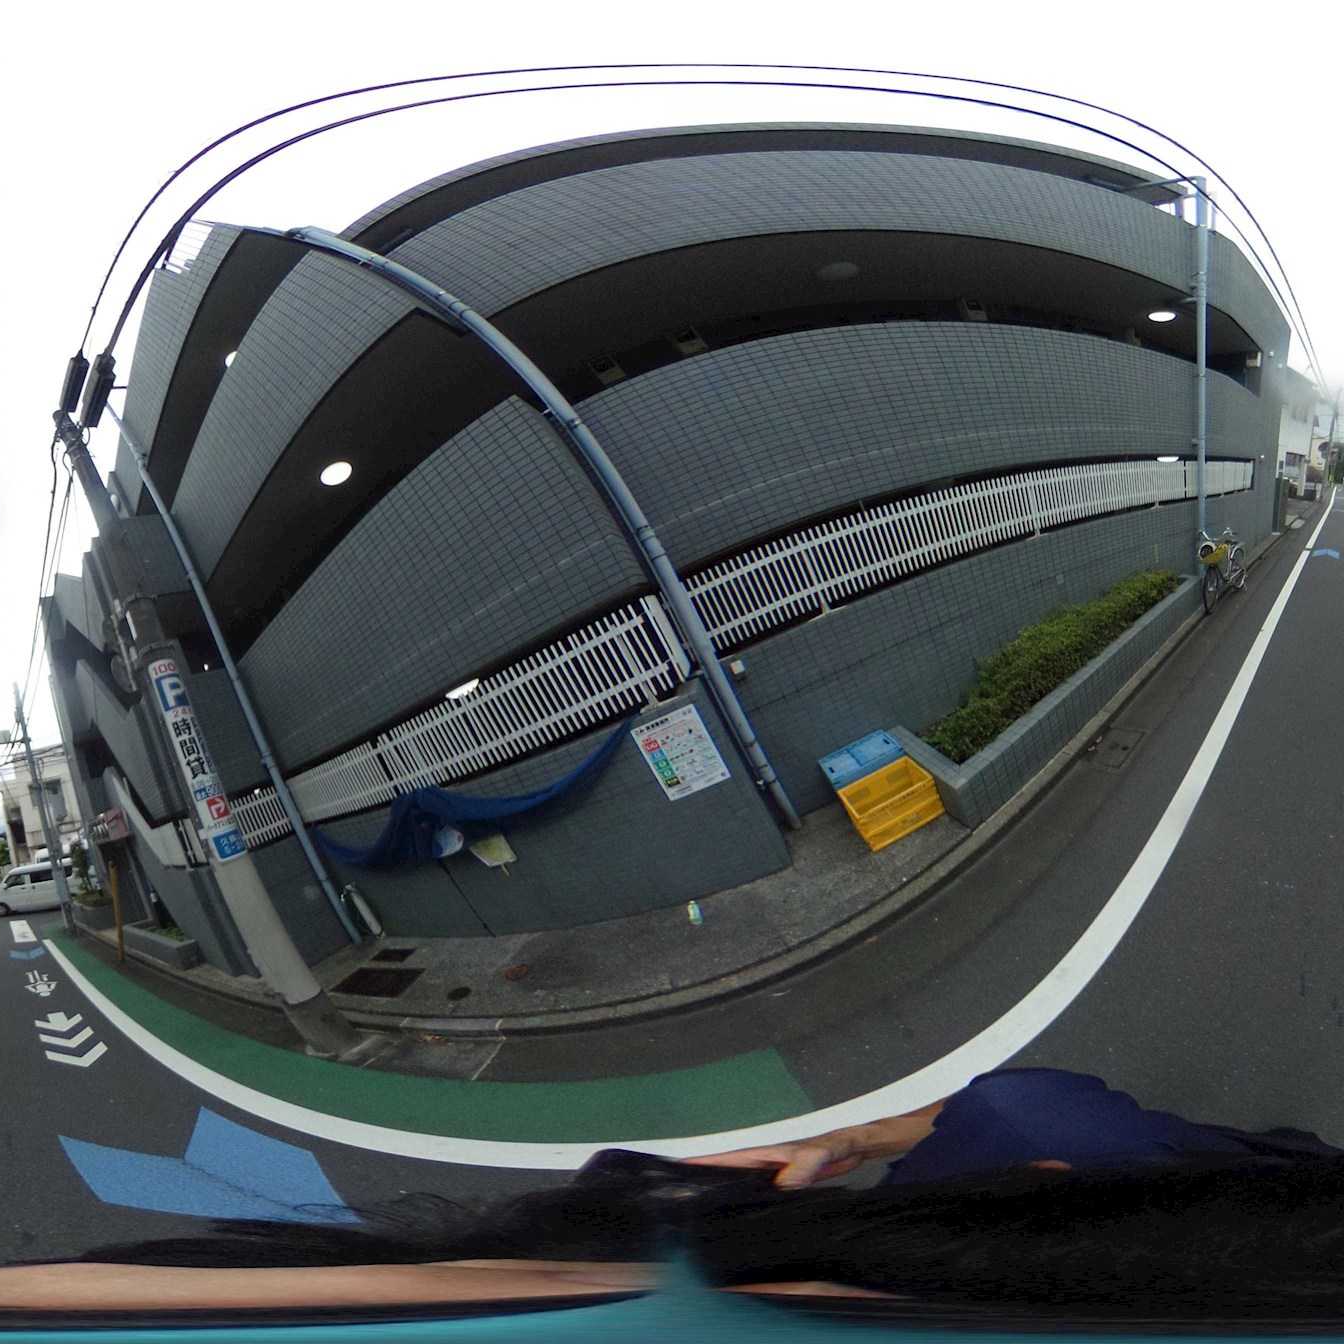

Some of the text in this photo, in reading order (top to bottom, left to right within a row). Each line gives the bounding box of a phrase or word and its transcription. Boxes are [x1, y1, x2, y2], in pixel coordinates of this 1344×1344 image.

[160, 677, 186, 709] P
[172, 717, 209, 780] 時間貸
